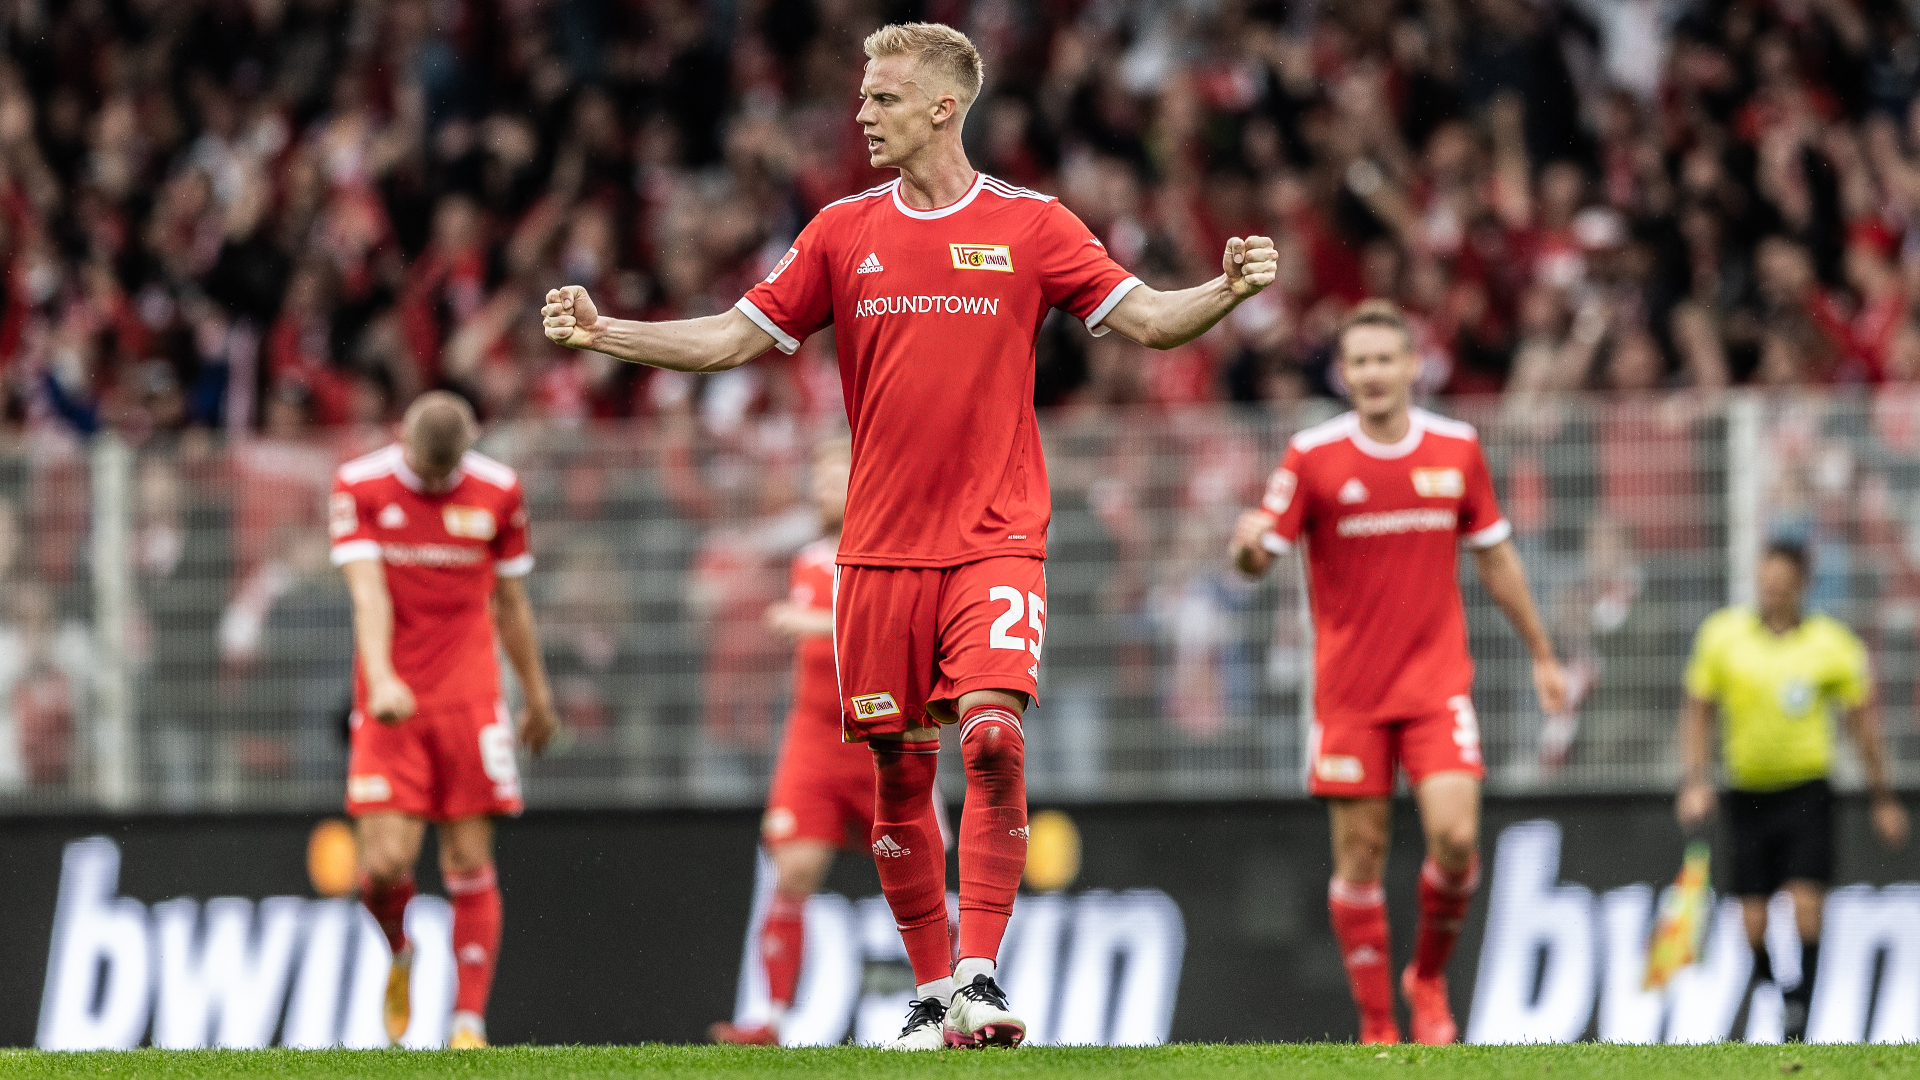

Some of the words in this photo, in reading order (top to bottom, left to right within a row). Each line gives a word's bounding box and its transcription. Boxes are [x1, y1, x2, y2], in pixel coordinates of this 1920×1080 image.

[984, 254, 1009, 266] UNION
[856, 265, 884, 275] adidas
[855, 295, 1000, 319] AROUNDTOWN
[989, 585, 1045, 661] 25
[872, 847, 911, 858] didas
